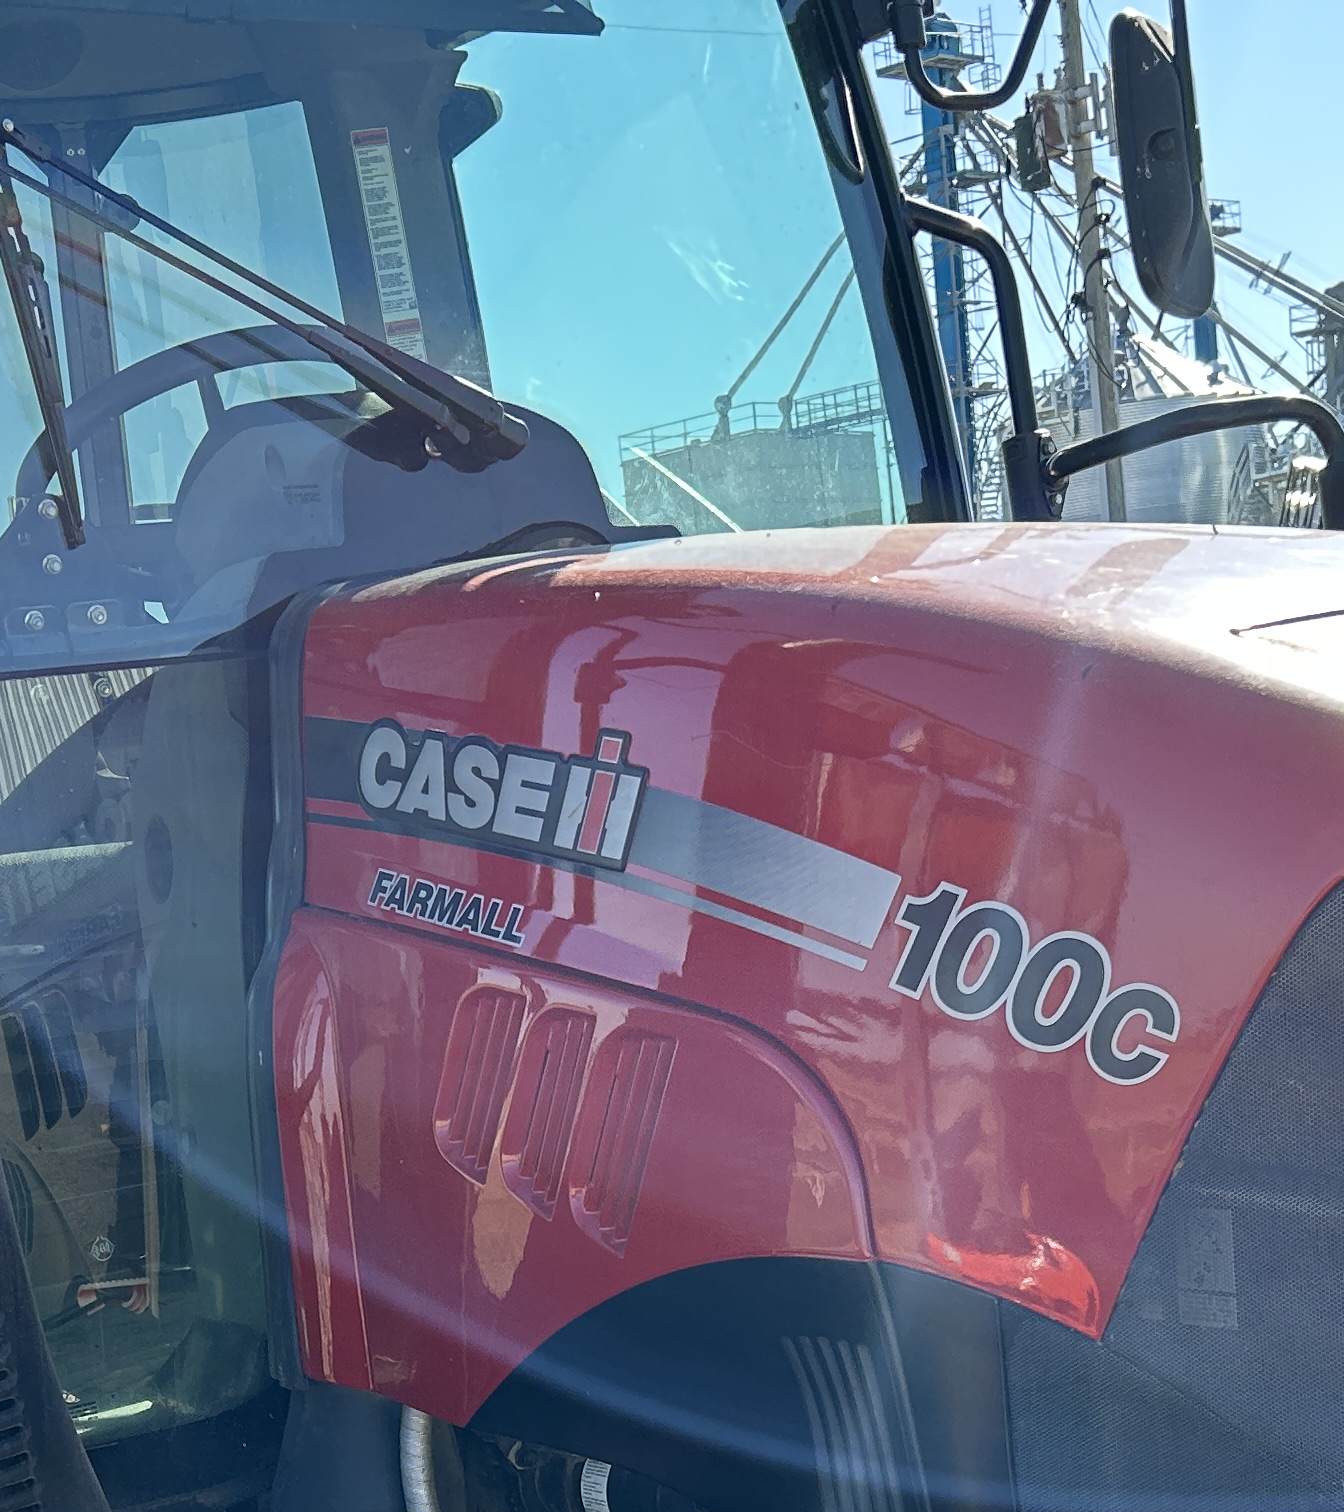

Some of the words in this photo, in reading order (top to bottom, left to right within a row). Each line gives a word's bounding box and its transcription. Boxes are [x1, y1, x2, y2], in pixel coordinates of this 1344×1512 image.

[359, 727, 556, 842] CASE
[368, 868, 524, 947] FARMALL
[888, 880, 1181, 1086] 100C
